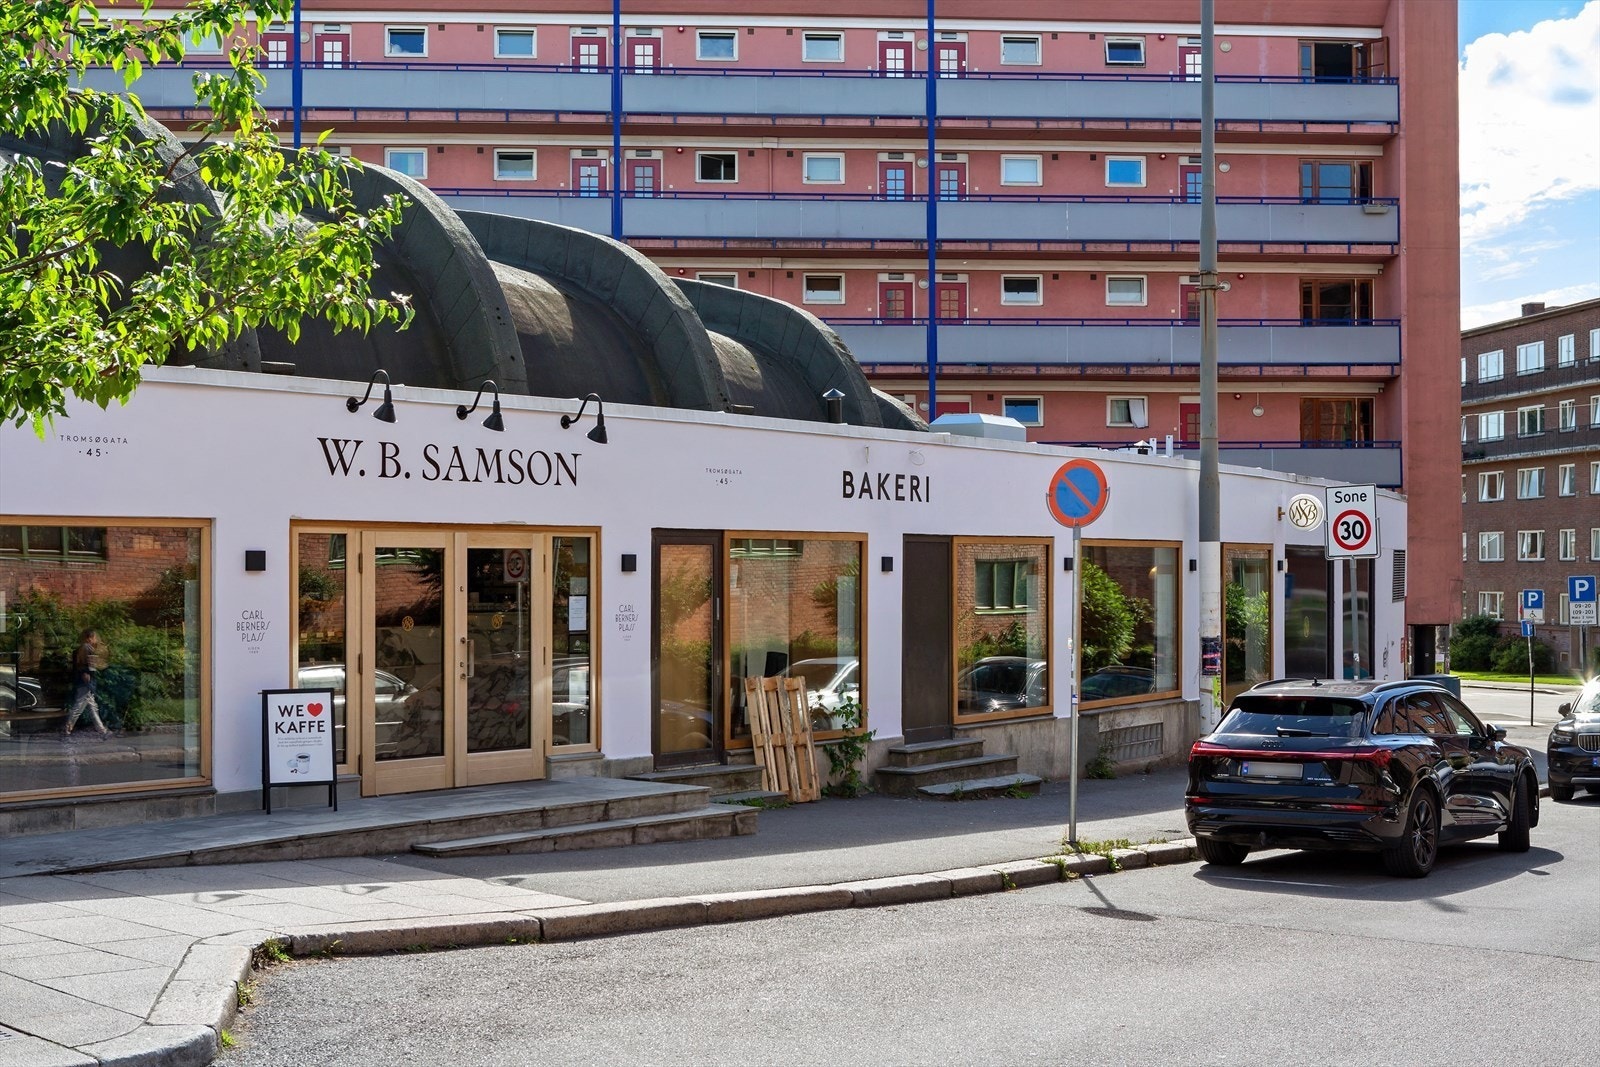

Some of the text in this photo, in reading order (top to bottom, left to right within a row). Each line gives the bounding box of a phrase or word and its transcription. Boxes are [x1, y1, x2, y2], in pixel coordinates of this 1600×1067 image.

[60, 434, 128, 444] TROMSØGATA
[317, 437, 582, 487] W. B. SAMSON
[842, 470, 930, 503] BAKERI
[1334, 491, 1367, 503] Sone
[1340, 520, 1364, 540] 30
[1574, 579, 1589, 599] P
[1528, 592, 1539, 607] P
[241, 610, 264, 620] CARL
[618, 604, 635, 613] CARL
[236, 621, 271, 631] BERNERS
[241, 632, 265, 642] PLASS
[278, 704, 304, 717] WE
[275, 720, 326, 734] KAFFE
